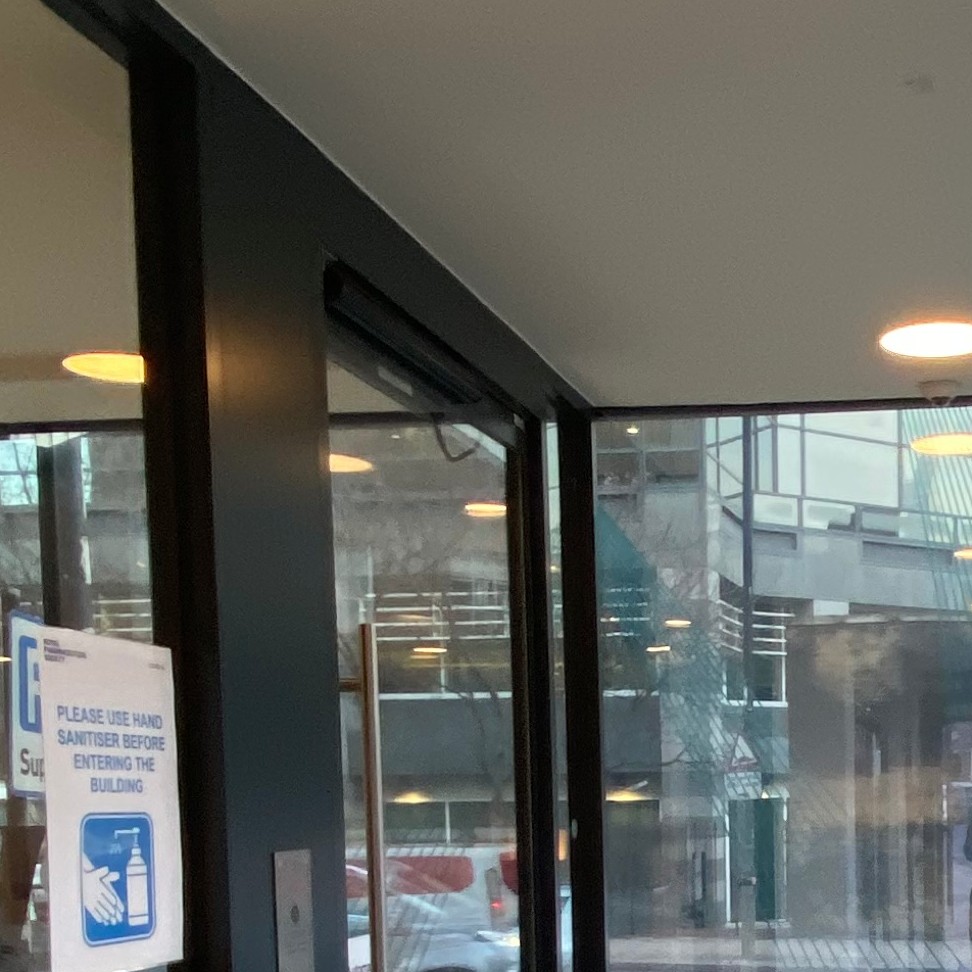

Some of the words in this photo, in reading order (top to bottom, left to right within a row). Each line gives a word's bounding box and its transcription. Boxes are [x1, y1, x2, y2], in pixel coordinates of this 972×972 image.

[57, 705, 105, 724] PLEASE
[106, 709, 130, 727] USE
[131, 713, 163, 730] HAND
[57, 729, 120, 747] SANITISER
[122, 734, 165, 751] BEFORE
[73, 754, 132, 772] ENTERING
[134, 757, 156, 772] THE
[90, 778, 144, 794] BUILDING
